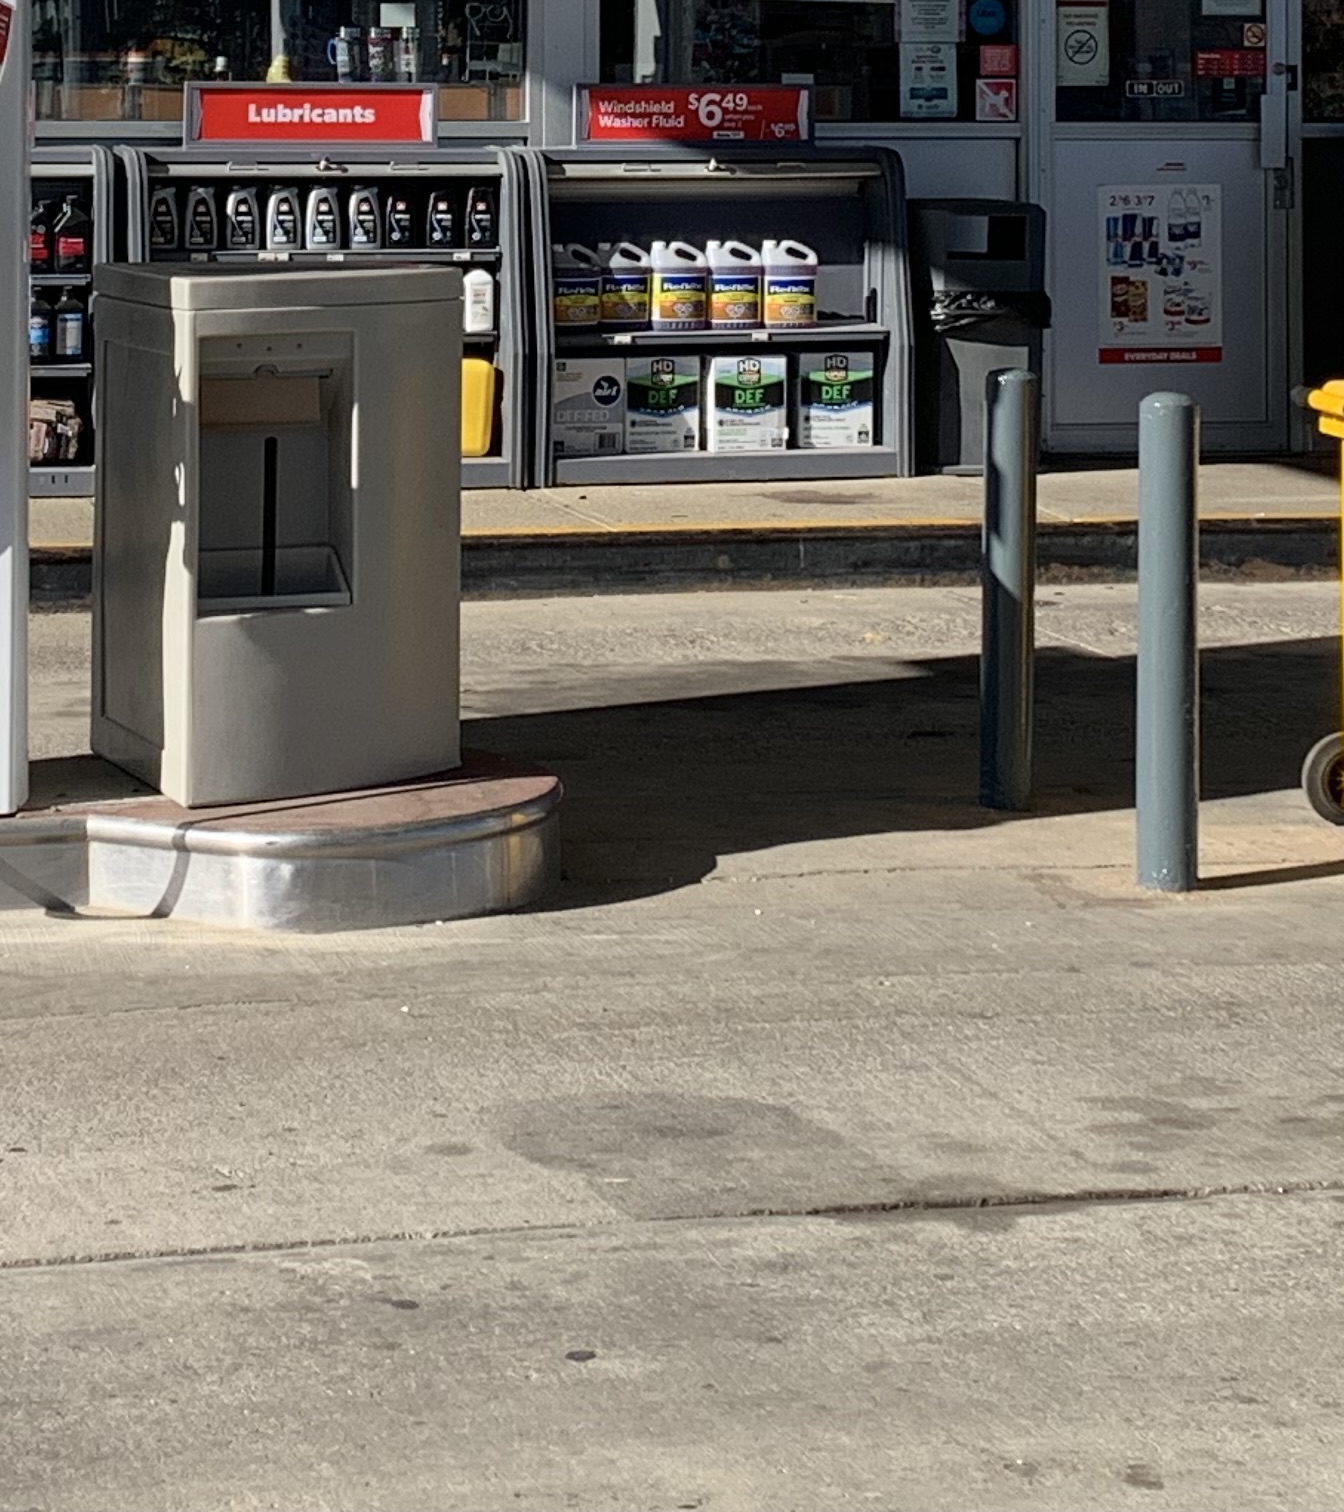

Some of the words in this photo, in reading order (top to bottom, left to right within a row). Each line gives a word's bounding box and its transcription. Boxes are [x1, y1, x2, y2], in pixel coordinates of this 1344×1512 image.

[1156, 82, 1180, 95] OUT
[247, 102, 376, 124] Lubricants
[598, 100, 675, 114] Windshield
[598, 114, 649, 128] Washer
[651, 114, 685, 128] Fluid
[652, 360, 673, 373] HD
[739, 359, 760, 372] HD
[826, 356, 847, 368] HD
[648, 389, 678, 404] DEF
[734, 389, 764, 404] DEF
[821, 385, 852, 400] DEF
